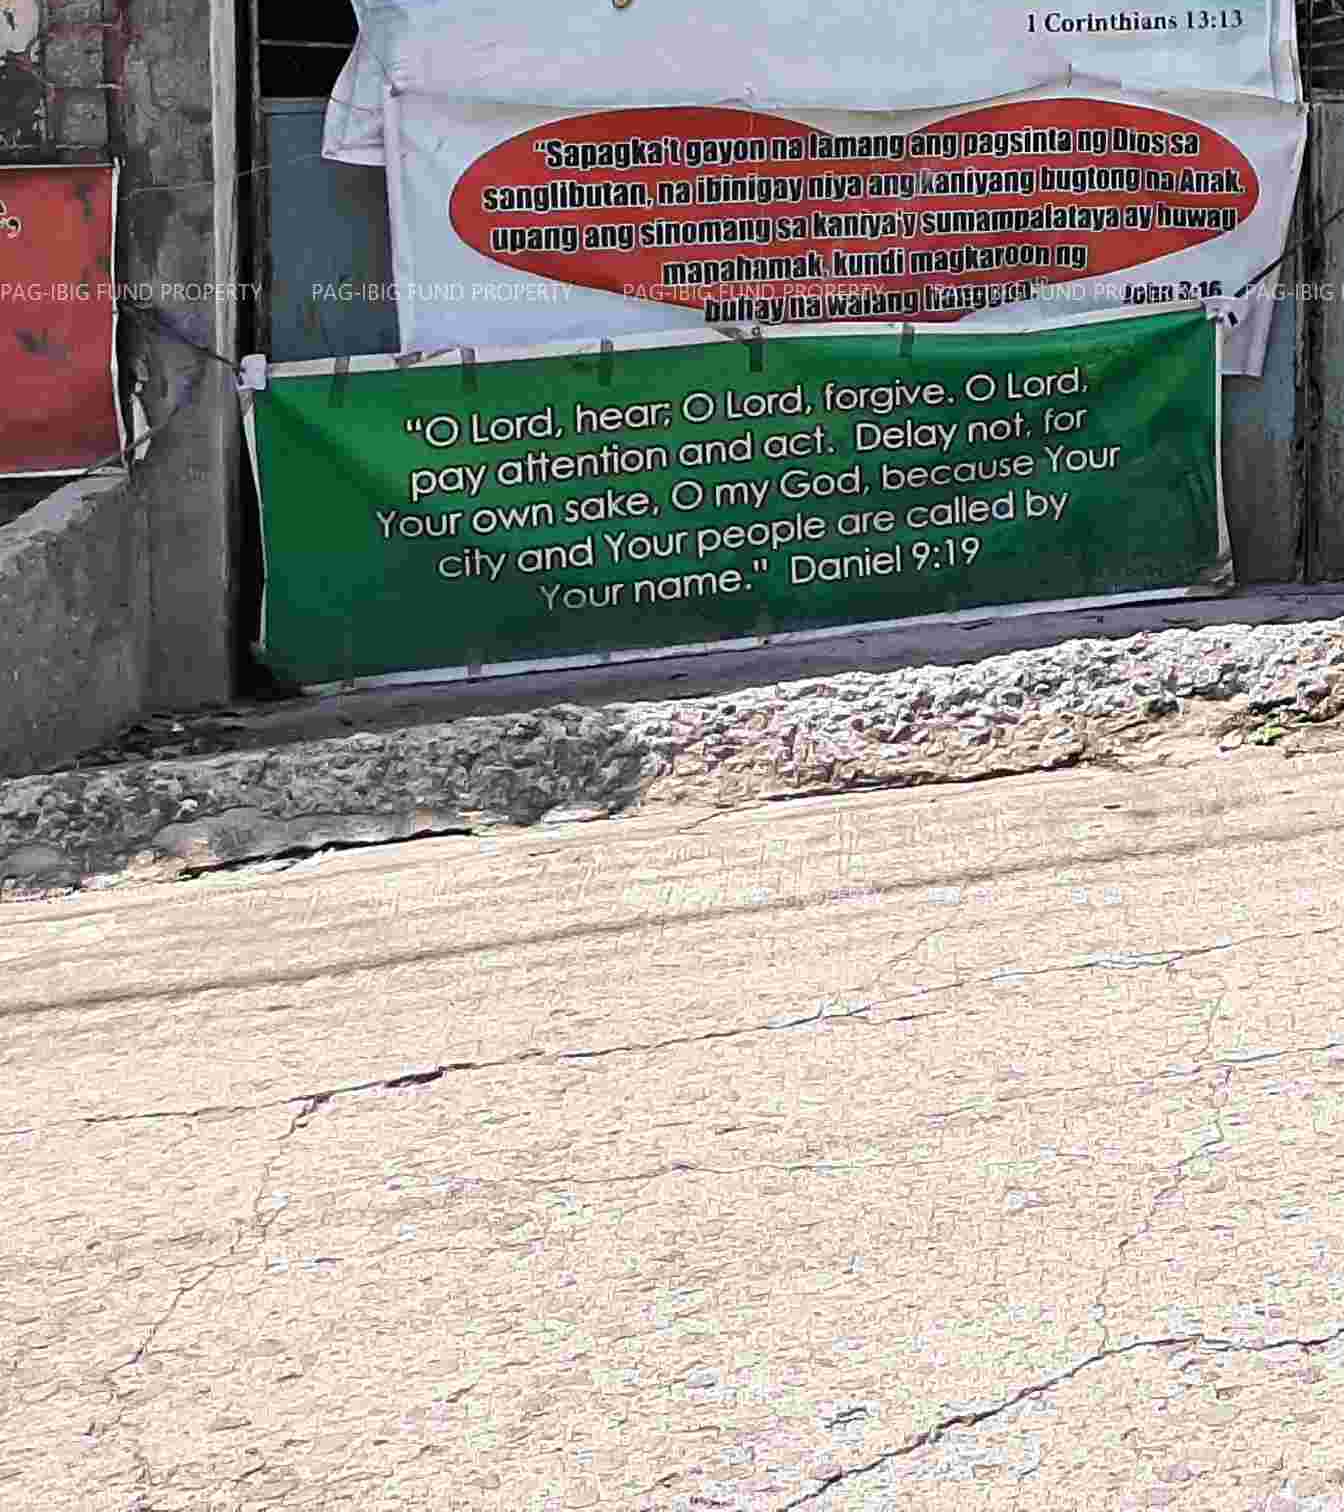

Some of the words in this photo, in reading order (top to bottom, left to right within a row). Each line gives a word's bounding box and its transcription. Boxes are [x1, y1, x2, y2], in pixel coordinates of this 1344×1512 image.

[1026, 13, 1038, 34] 1
[1044, 10, 1177, 34] Corinthians
[1186, 9, 1243, 30] 13:13
[686, 137, 765, 167] gayon
[771, 137, 801, 162] na
[808, 133, 903, 160] lamang
[911, 133, 959, 158] ang
[963, 129, 1072, 157] pagsinta
[1076, 131, 1107, 154] ng
[1112, 127, 1169, 154] Dios
[1169, 132, 1199, 154] sa
[483, 180, 654, 212] sanglibutan,
[658, 181, 691, 205] na
[696, 175, 803, 204] ibinigay
[807, 173, 861, 200] niya
[868, 172, 914, 198] ang
[920, 167, 1033, 198] kaniyang
[1040, 167, 1140, 194] bugtong
[1145, 170, 1178, 192] na
[491, 224, 578, 253] upang
[584, 223, 633, 249] ang
[640, 218, 771, 246] sinomang
[776, 217, 809, 240] sa
[921, 203, 1119, 235] sumampalataya
[1123, 206, 1152, 232] ay
[1157, 203, 1238, 232] huwag
[834, 247, 902, 276] kundi
[911, 245, 1048, 274] magkaroon
[1054, 244, 1088, 270] ng
[471, 407, 563, 444] Lord,
[682, 392, 714, 423] O
[726, 385, 813, 419] Lord,
[825, 381, 954, 415] forgive.
[965, 374, 995, 402] O
[1007, 367, 1088, 399] Lord,
[410, 464, 486, 502] pay
[498, 443, 667, 486] attention
[679, 433, 752, 467] and
[763, 426, 834, 458] act.
[855, 420, 957, 452] Delay
[967, 412, 1031, 443] not,
[1043, 407, 1088, 434] for
[376, 509, 462, 539] Your
[472, 502, 554, 533] own
[564, 491, 660, 524] sake,
[672, 480, 703, 511] O
[715, 479, 769, 507] my
[780, 465, 871, 500] God,
[882, 454, 1034, 491] because
[1045, 444, 1121, 473] Your
[438, 548, 505, 581] city
[518, 536, 593, 573] and
[603, 529, 688, 563] Your
[697, 514, 826, 551] people
[838, 510, 896, 536] are
[906, 490, 1014, 529] called
[1026, 489, 1069, 521] by
[540, 582, 624, 611] Your
[790, 544, 901, 585] Daniel
[912, 536, 981, 572] 9:19
